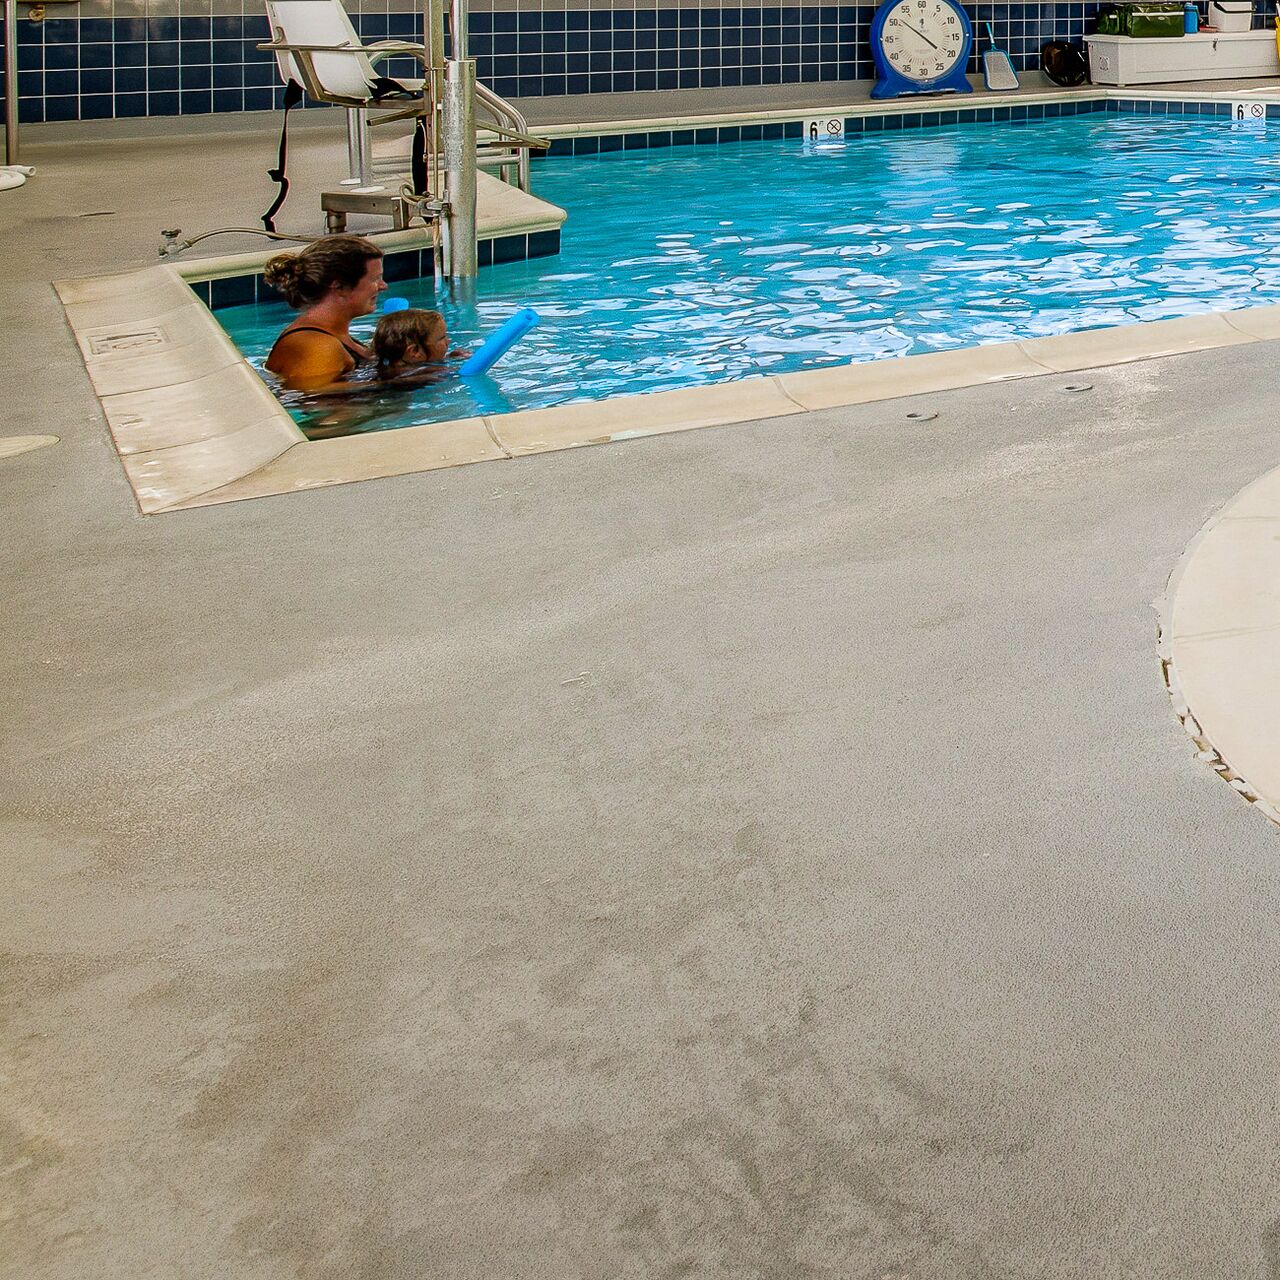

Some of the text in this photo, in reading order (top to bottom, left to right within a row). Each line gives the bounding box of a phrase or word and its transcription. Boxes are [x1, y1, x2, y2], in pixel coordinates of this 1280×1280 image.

[917, 0, 927, 9] 60
[901, 5, 910, 13] 55
[889, 18, 898, 26] 50
[947, 16, 955, 24] 10
[890, 53, 899, 61] 40
[947, 50, 956, 58] 20
[902, 65, 912, 73] 35
[935, 63, 945, 71] 25
[1237, 104, 1244, 120] 6
[810, 121, 818, 140] 6
